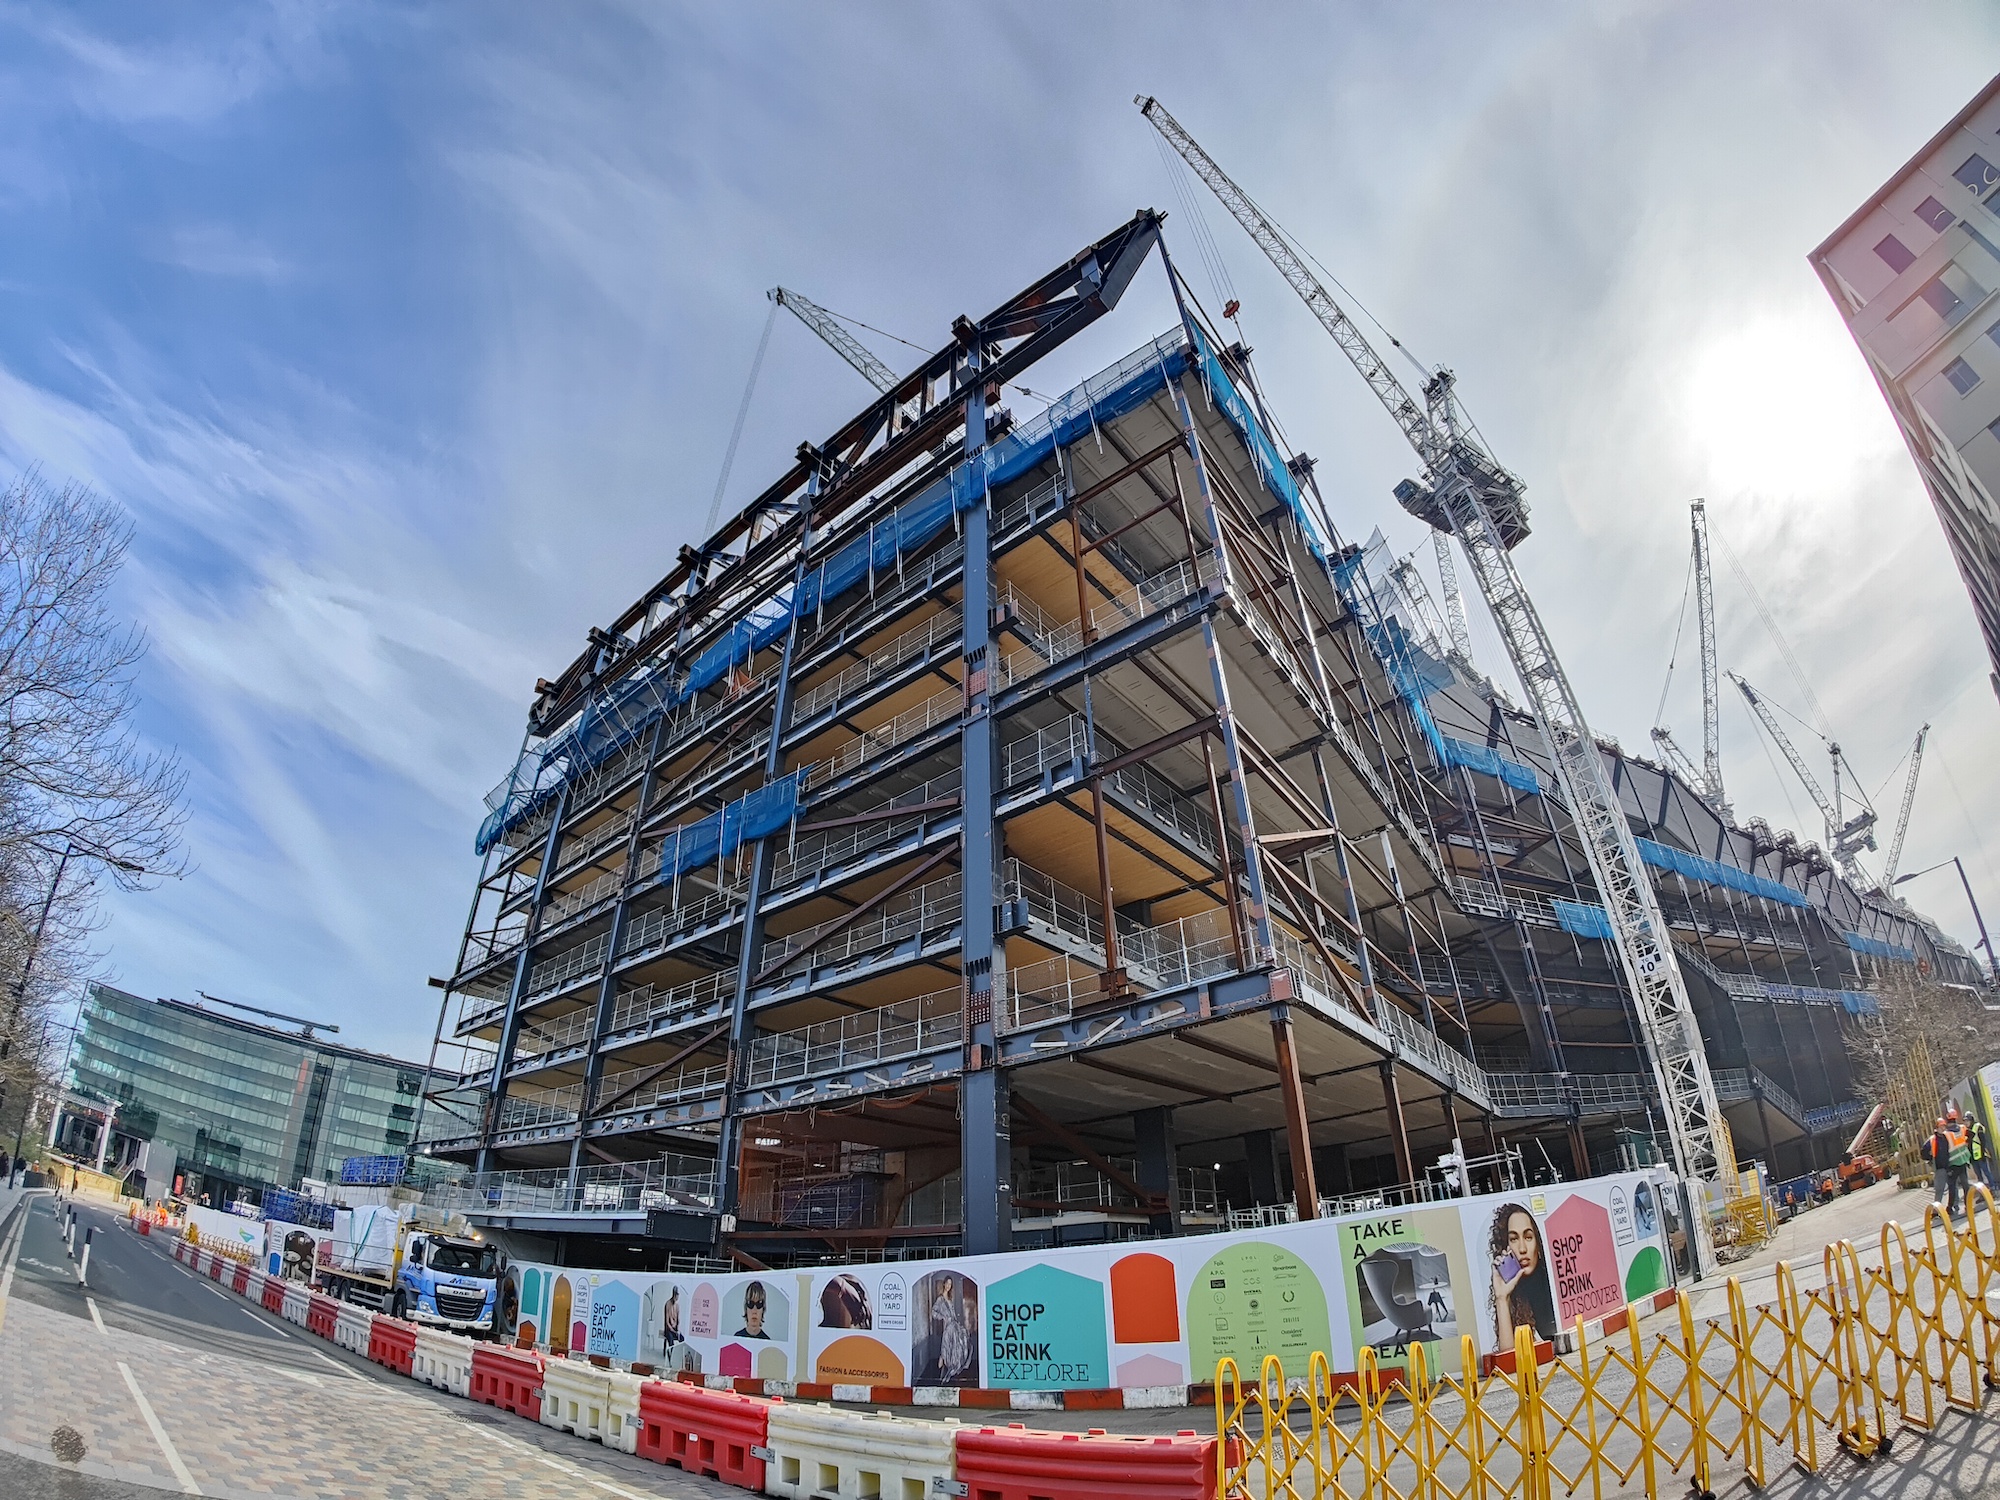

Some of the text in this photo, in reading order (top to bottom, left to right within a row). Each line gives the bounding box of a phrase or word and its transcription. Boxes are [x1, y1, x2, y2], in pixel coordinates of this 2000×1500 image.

[1640, 961, 1655, 974] 10
[1350, 1219, 1404, 1241] TAKE
[1353, 1243, 1367, 1260] A
[1552, 1234, 1583, 1258] SHOP
[1556, 1255, 1577, 1278] EAT
[883, 1283, 901, 1291] COAL
[1243, 1277, 1261, 1286] COS
[1560, 1271, 1594, 1299] DRINK
[881, 1293, 903, 1301] DROPS
[1562, 1284, 1620, 1319] DISCOVER
[593, 1302, 616, 1316] SHOP
[883, 1302, 901, 1310] YARD
[991, 1303, 1045, 1322] SHOP
[592, 1315, 608, 1328] EAT
[591, 1326, 616, 1342] DRINK
[992, 1323, 1028, 1341] EAT
[590, 1338, 619, 1356] RELAX
[992, 1342, 1052, 1361] DRINK
[819, 1365, 843, 1375] FASHION
[848, 1369, 889, 1380] ACCESSORIES
[992, 1362, 1090, 1382] EXPLORE
